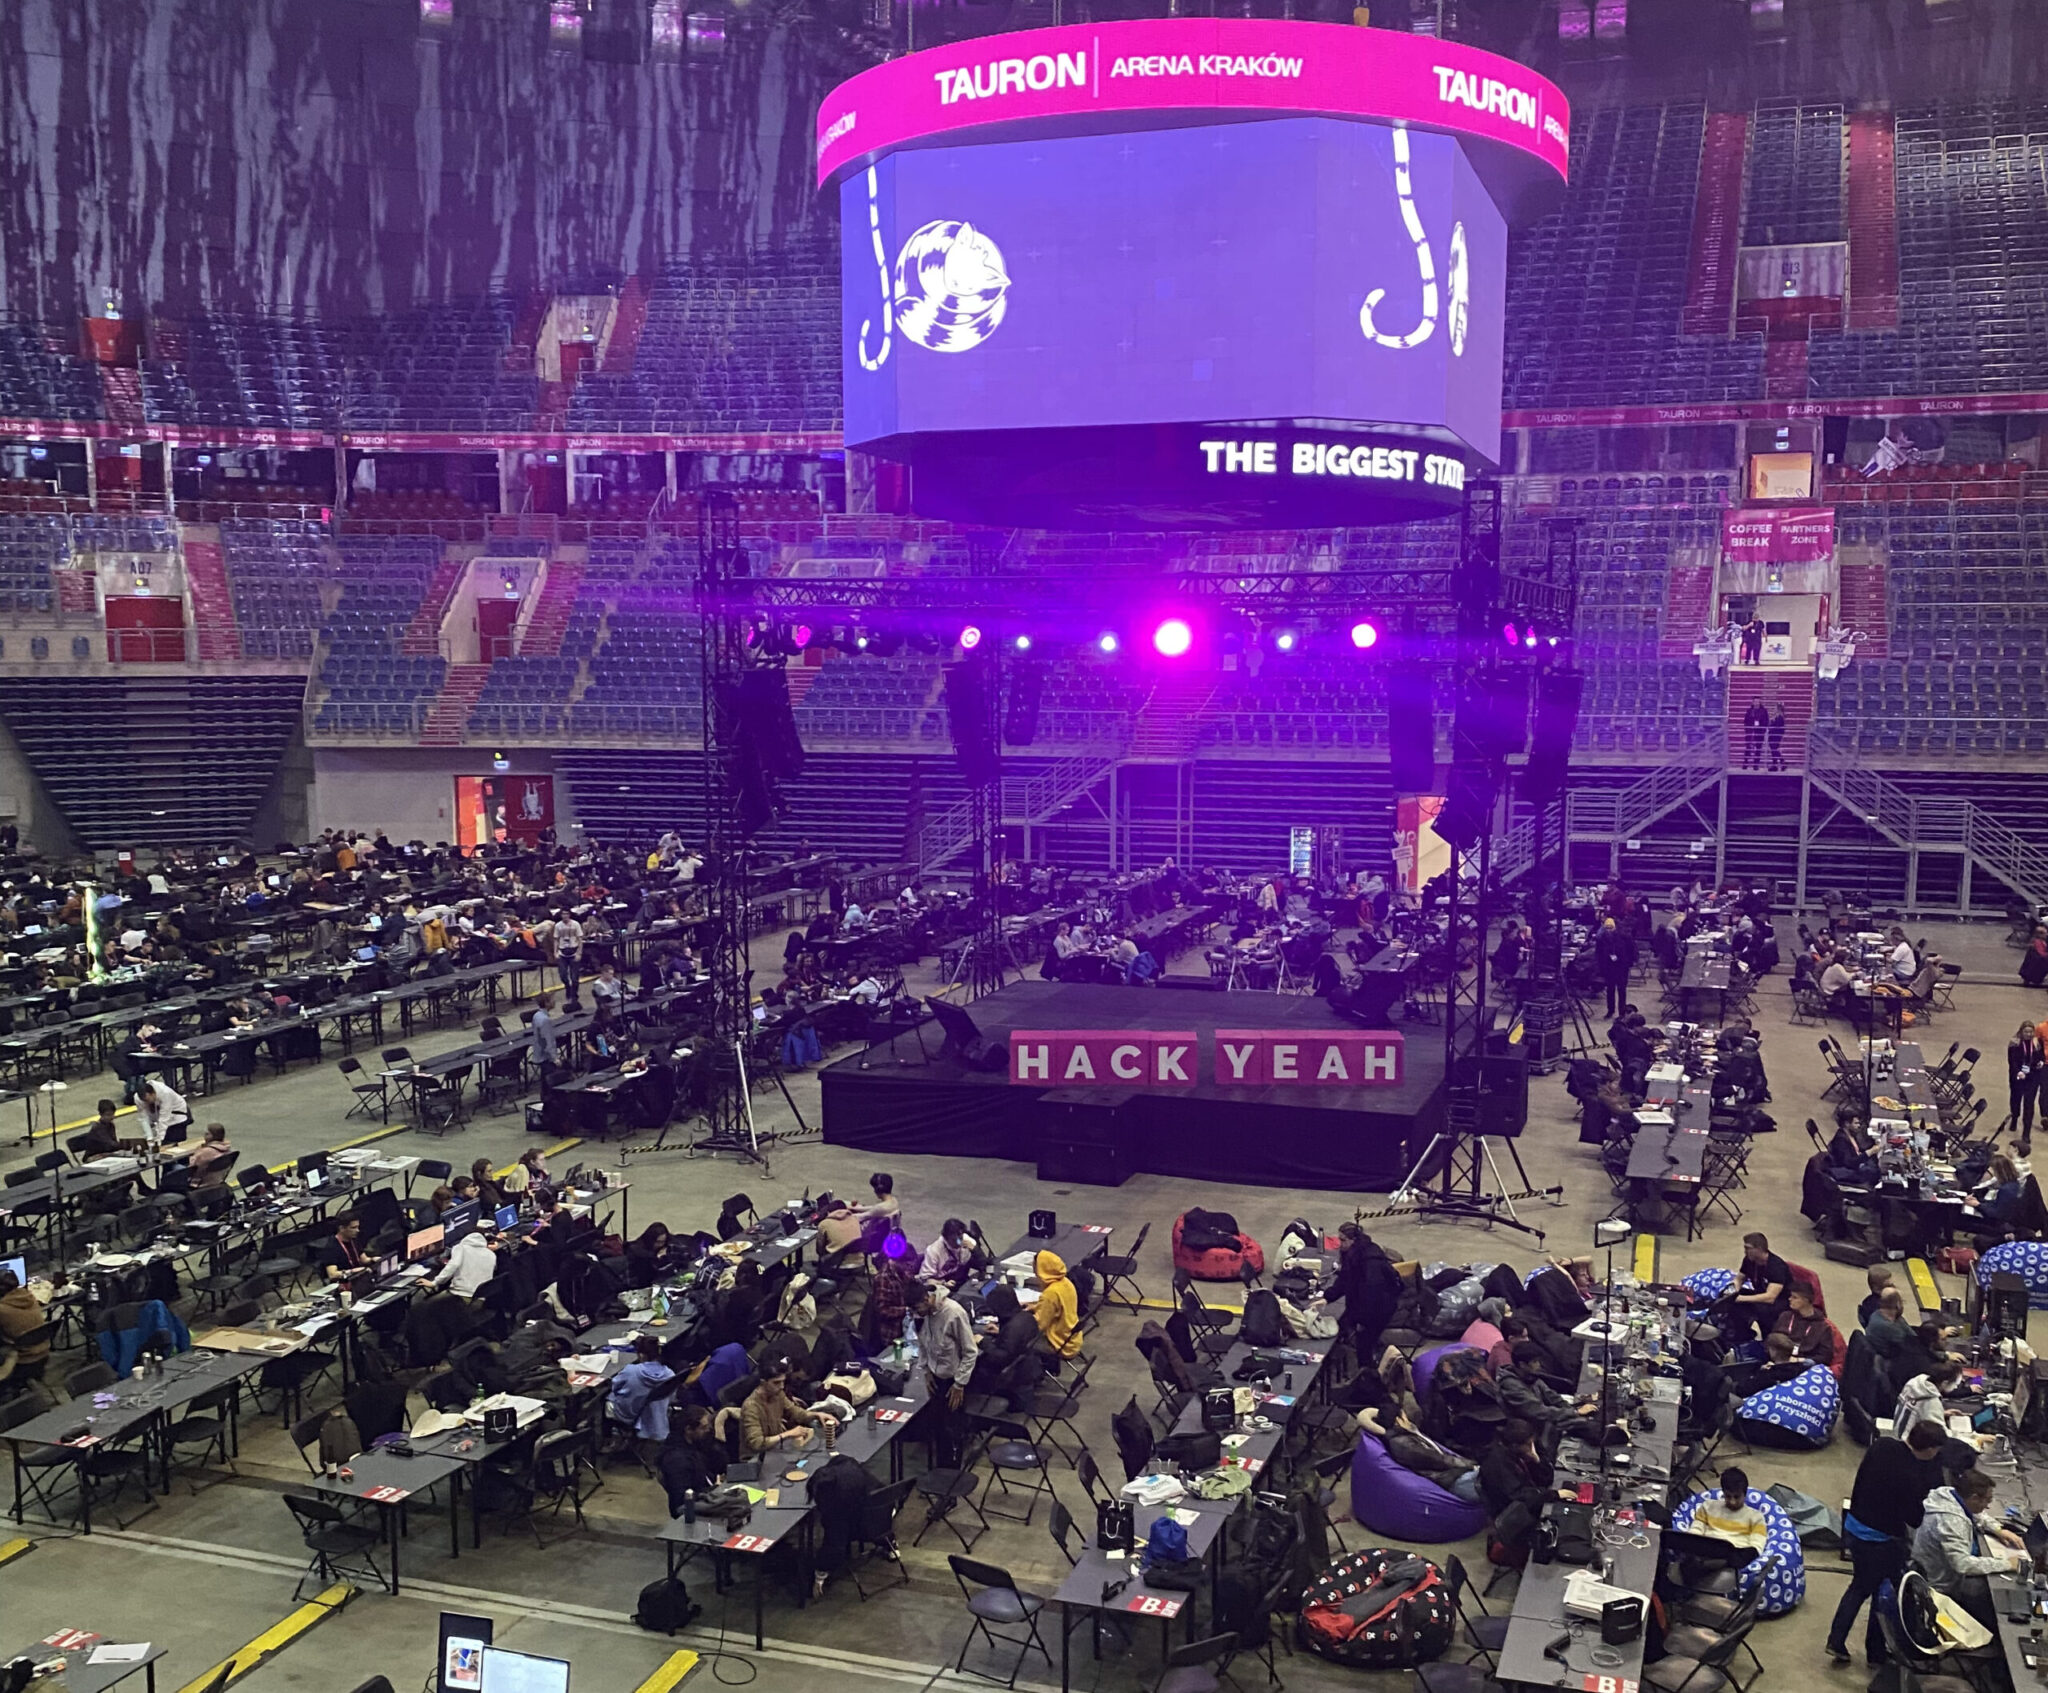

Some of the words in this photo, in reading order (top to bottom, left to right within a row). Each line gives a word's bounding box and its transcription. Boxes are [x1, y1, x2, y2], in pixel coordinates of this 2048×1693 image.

[934, 51, 1086, 105] TAURON
[1109, 54, 1195, 78] ARENA
[1198, 52, 1304, 78] KRAKÓW
[1432, 65, 1536, 129] TAURON
[1199, 441, 1277, 473] THE
[1292, 443, 1419, 481] BIGGEST
[1728, 524, 1773, 534] COFFEE
[1780, 525, 1831, 534] PARTNERS
[1731, 537, 1770, 547] BREAK
[1791, 536, 1818, 545] ZONE
[130, 561, 152, 575] A07
[1016, 1044, 1190, 1081] HACK
[1222, 1044, 1396, 1081] YEAH
[1775, 1393, 1826, 1419] Laboratoria
[879, 1409, 899, 1421] B
[734, 1535, 757, 1549] B
[1139, 1597, 1162, 1612] B
[1598, 1675, 1617, 1693] B
